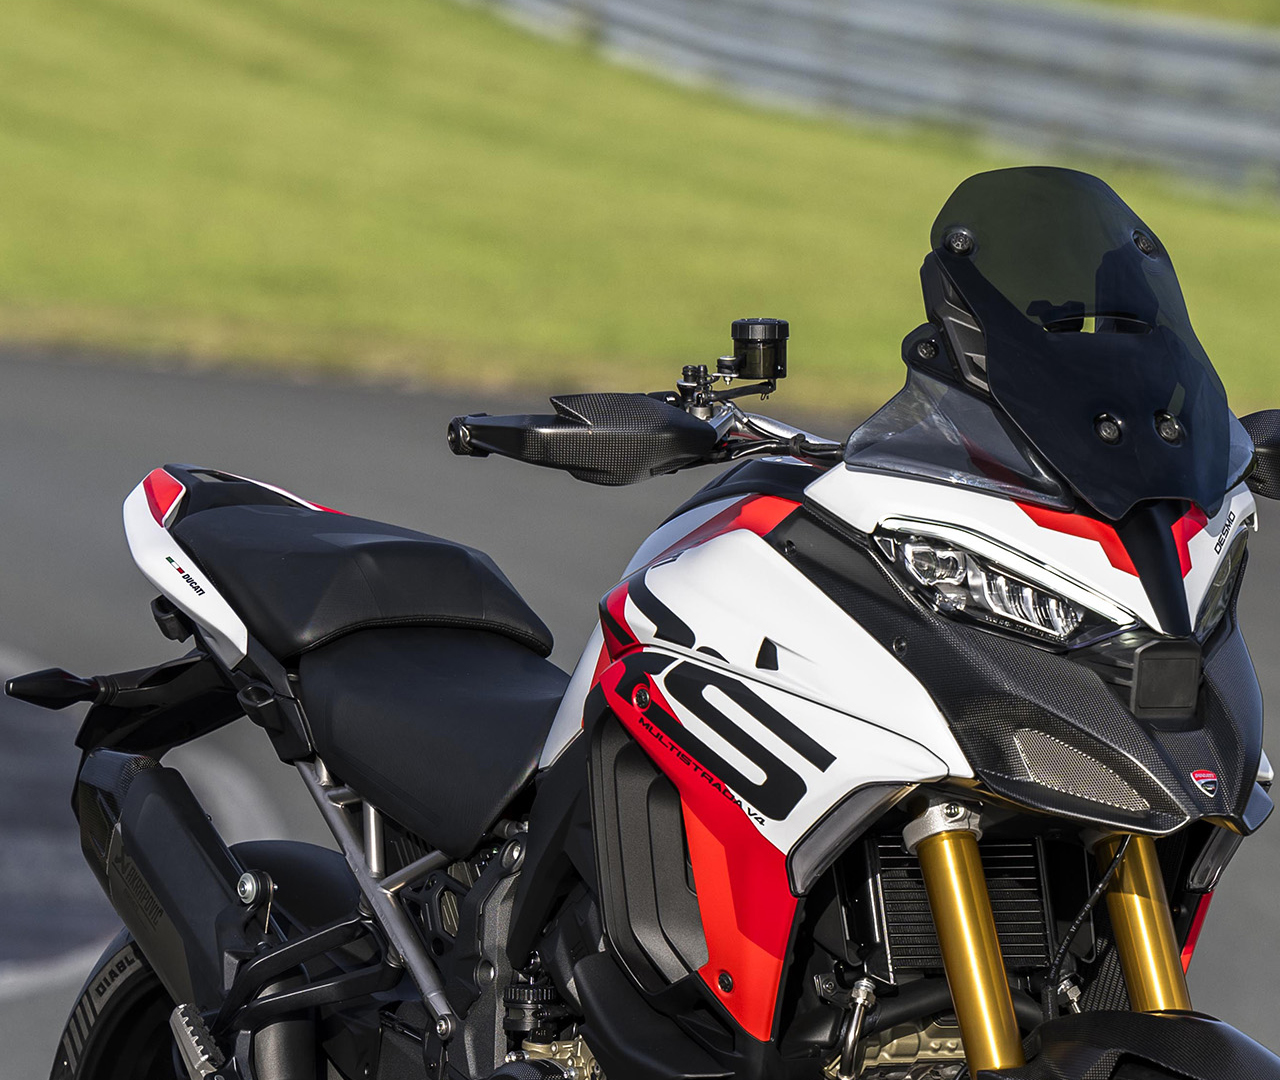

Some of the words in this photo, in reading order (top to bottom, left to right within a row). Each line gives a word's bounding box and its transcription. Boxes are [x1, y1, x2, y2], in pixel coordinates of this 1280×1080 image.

[1214, 511, 1236, 555] DESMO
[182, 574, 206, 596] DUCATI
[638, 717, 743, 808] MULTISTRADA
[747, 806, 766, 826] V4
[95, 950, 141, 998] DIABL
